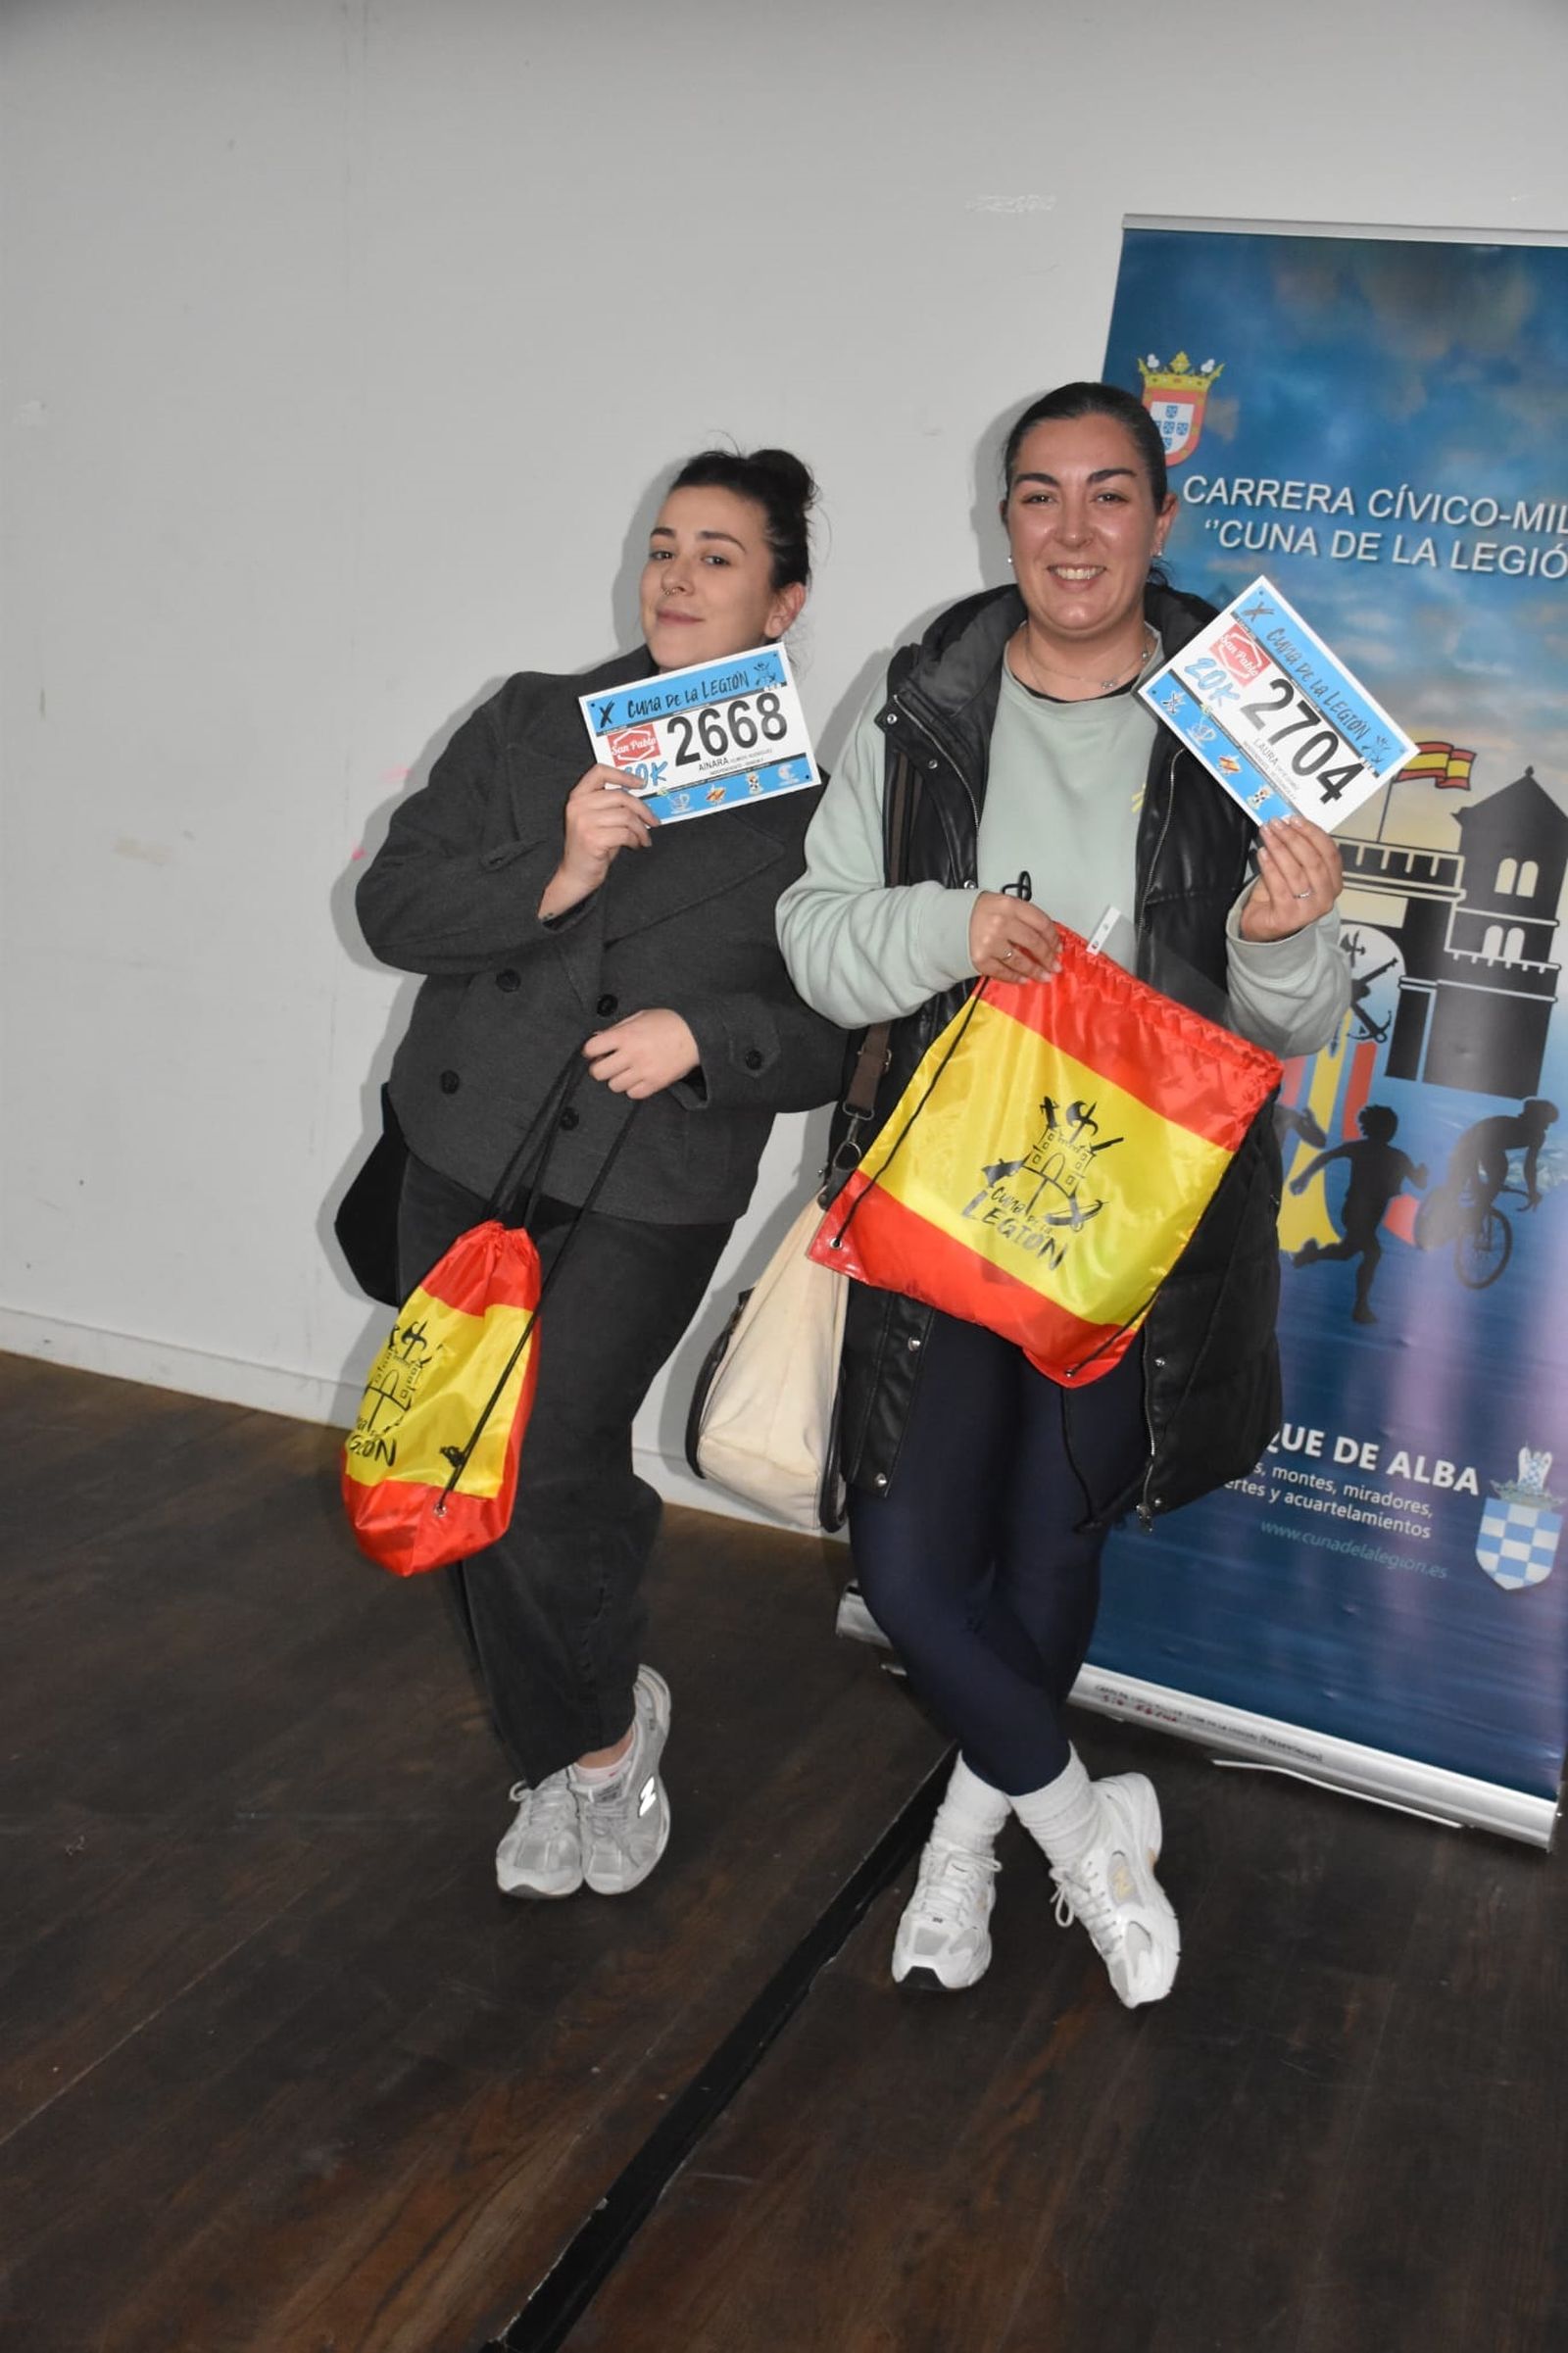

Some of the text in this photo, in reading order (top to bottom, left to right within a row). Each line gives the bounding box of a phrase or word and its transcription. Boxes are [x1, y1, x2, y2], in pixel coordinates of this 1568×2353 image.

[1183, 474, 1355, 515] CARRERA
[1331, 529, 1382, 562] DE
[1392, 534, 1438, 567] LA
[1450, 540, 1568, 579] LEGIÓ
[1184, 658, 1240, 708] 20K
[612, 736, 656, 756] San Pablo
[666, 693, 788, 767] 2668
[1240, 678, 1365, 805] 2704
[623, 760, 668, 789] 0K
[699, 757, 728, 771] AINARA
[1272, 1465, 1338, 1495] montes,
[1343, 1483, 1434, 1518] miradores,
[1333, 1436, 1380, 1471] DE
[1386, 1450, 1480, 1496] ALBA
[1268, 1488, 1282, 1504] y
[1284, 1490, 1433, 1540] acuartelamientos
[1260, 1520, 1448, 1580] www.cunadelalegion.es
